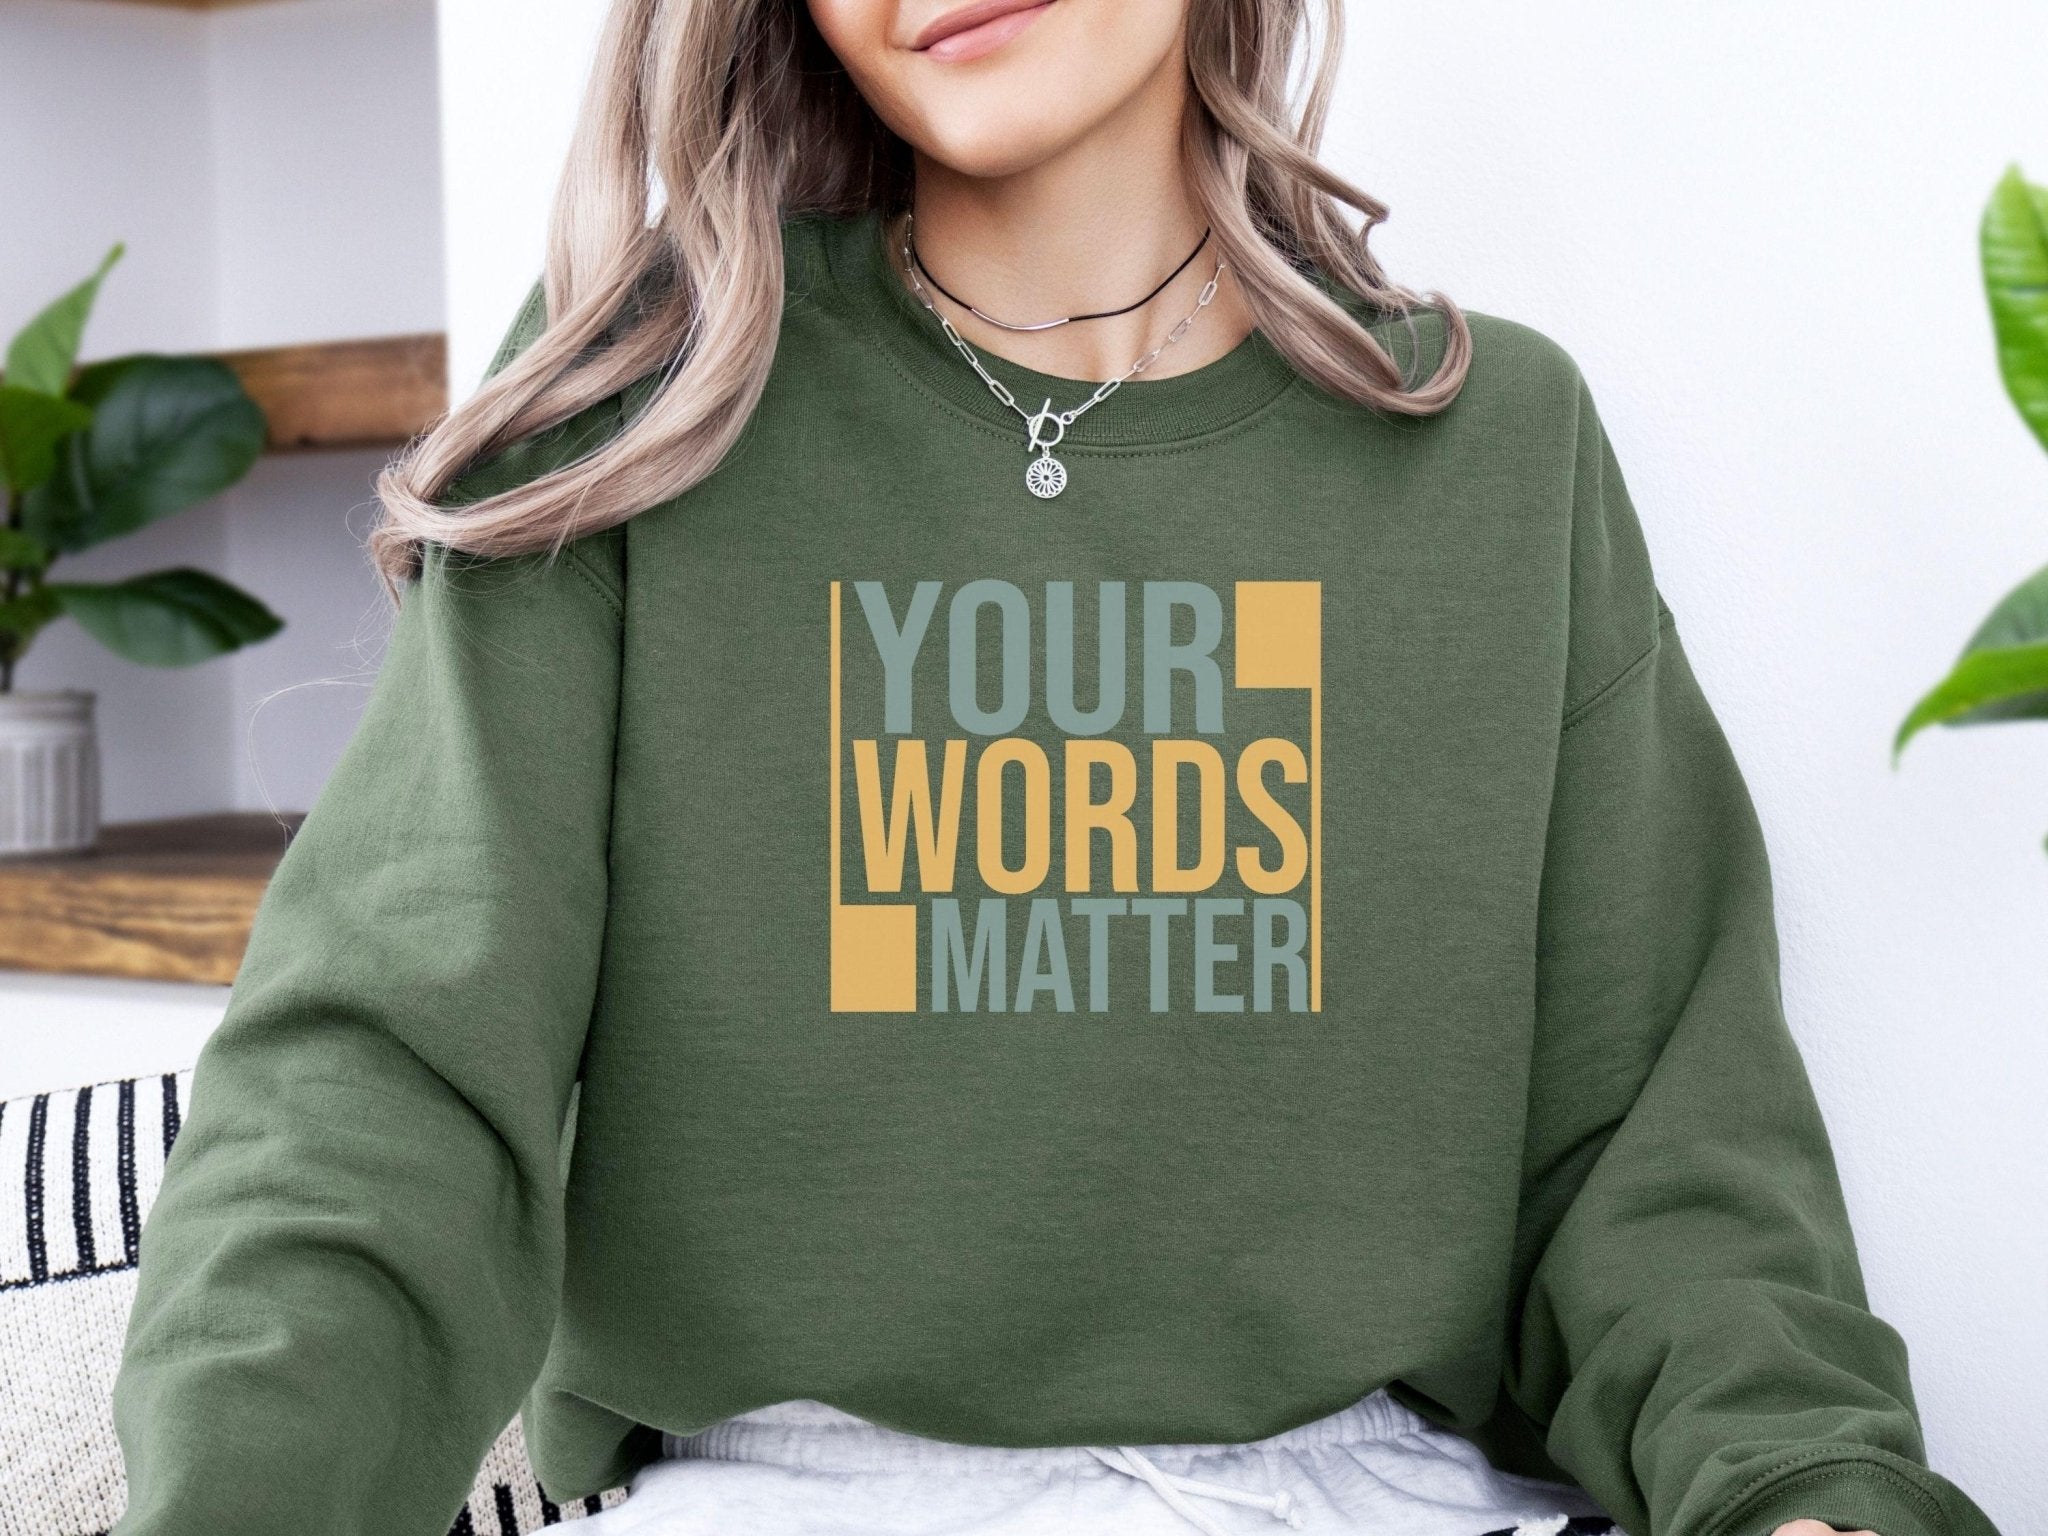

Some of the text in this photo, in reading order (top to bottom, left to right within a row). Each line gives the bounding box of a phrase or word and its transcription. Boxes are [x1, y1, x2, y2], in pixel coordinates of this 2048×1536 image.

[854, 579, 1225, 736] YOUR
[853, 738, 1308, 894] WORDS
[931, 898, 1311, 1012] MATTER
